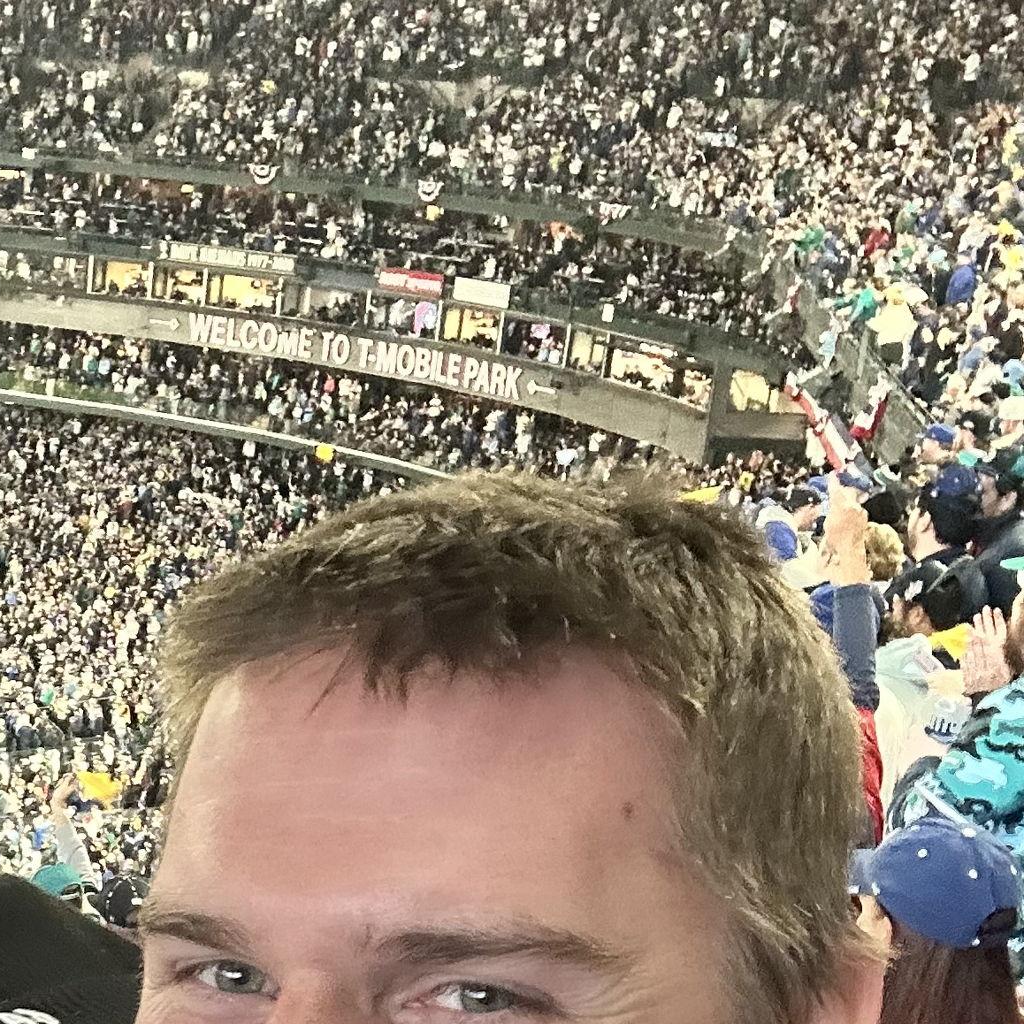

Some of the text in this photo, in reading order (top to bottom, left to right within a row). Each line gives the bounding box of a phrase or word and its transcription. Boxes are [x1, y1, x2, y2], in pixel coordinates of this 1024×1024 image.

[189, 312, 523, 400] WELCOME TO T-MOBILE PARK
